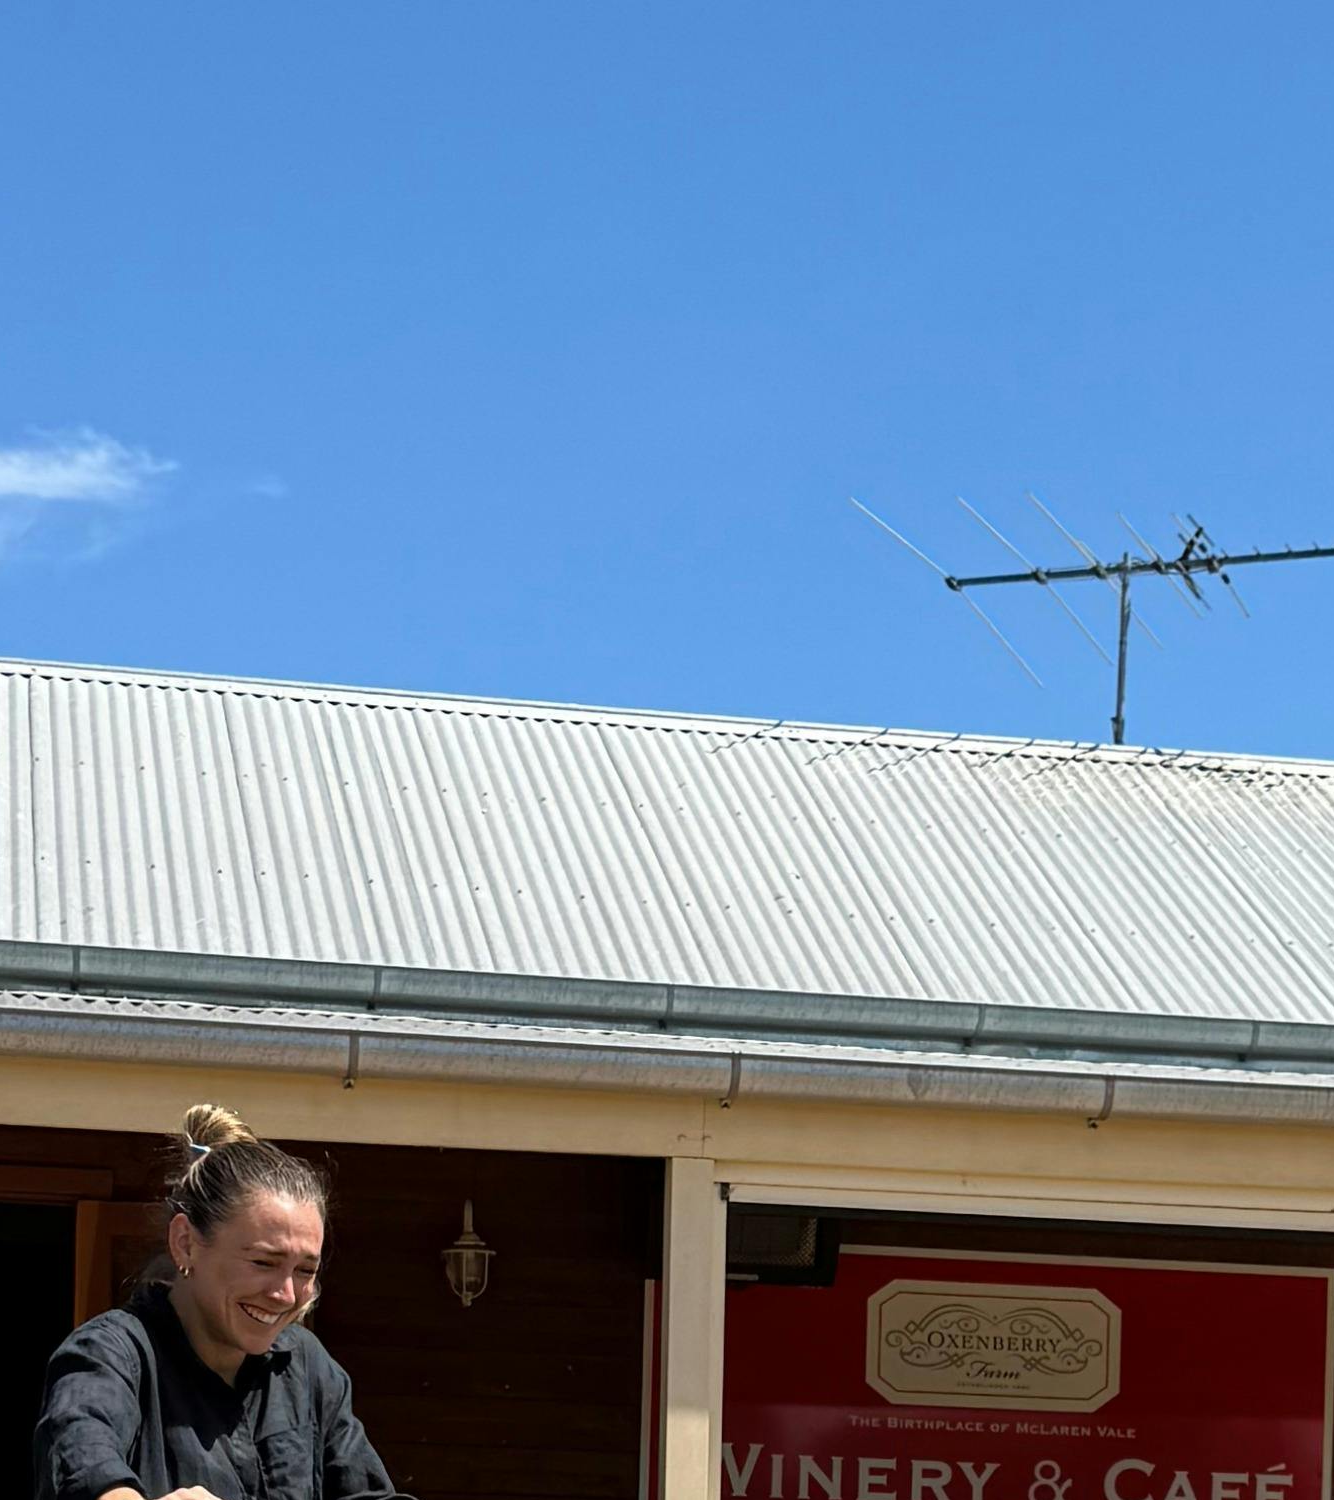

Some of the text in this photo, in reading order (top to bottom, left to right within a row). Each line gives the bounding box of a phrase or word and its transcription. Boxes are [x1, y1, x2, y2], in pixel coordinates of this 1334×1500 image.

[926, 1330, 1062, 1354] OXENBERRY
[966, 1360, 1021, 1380] Farm
[849, 1414, 882, 1429] THE
[887, 1415, 985, 1433] BIRTHPLACE
[990, 1421, 1011, 1434] OF
[1096, 1425, 1137, 1440] VALE
